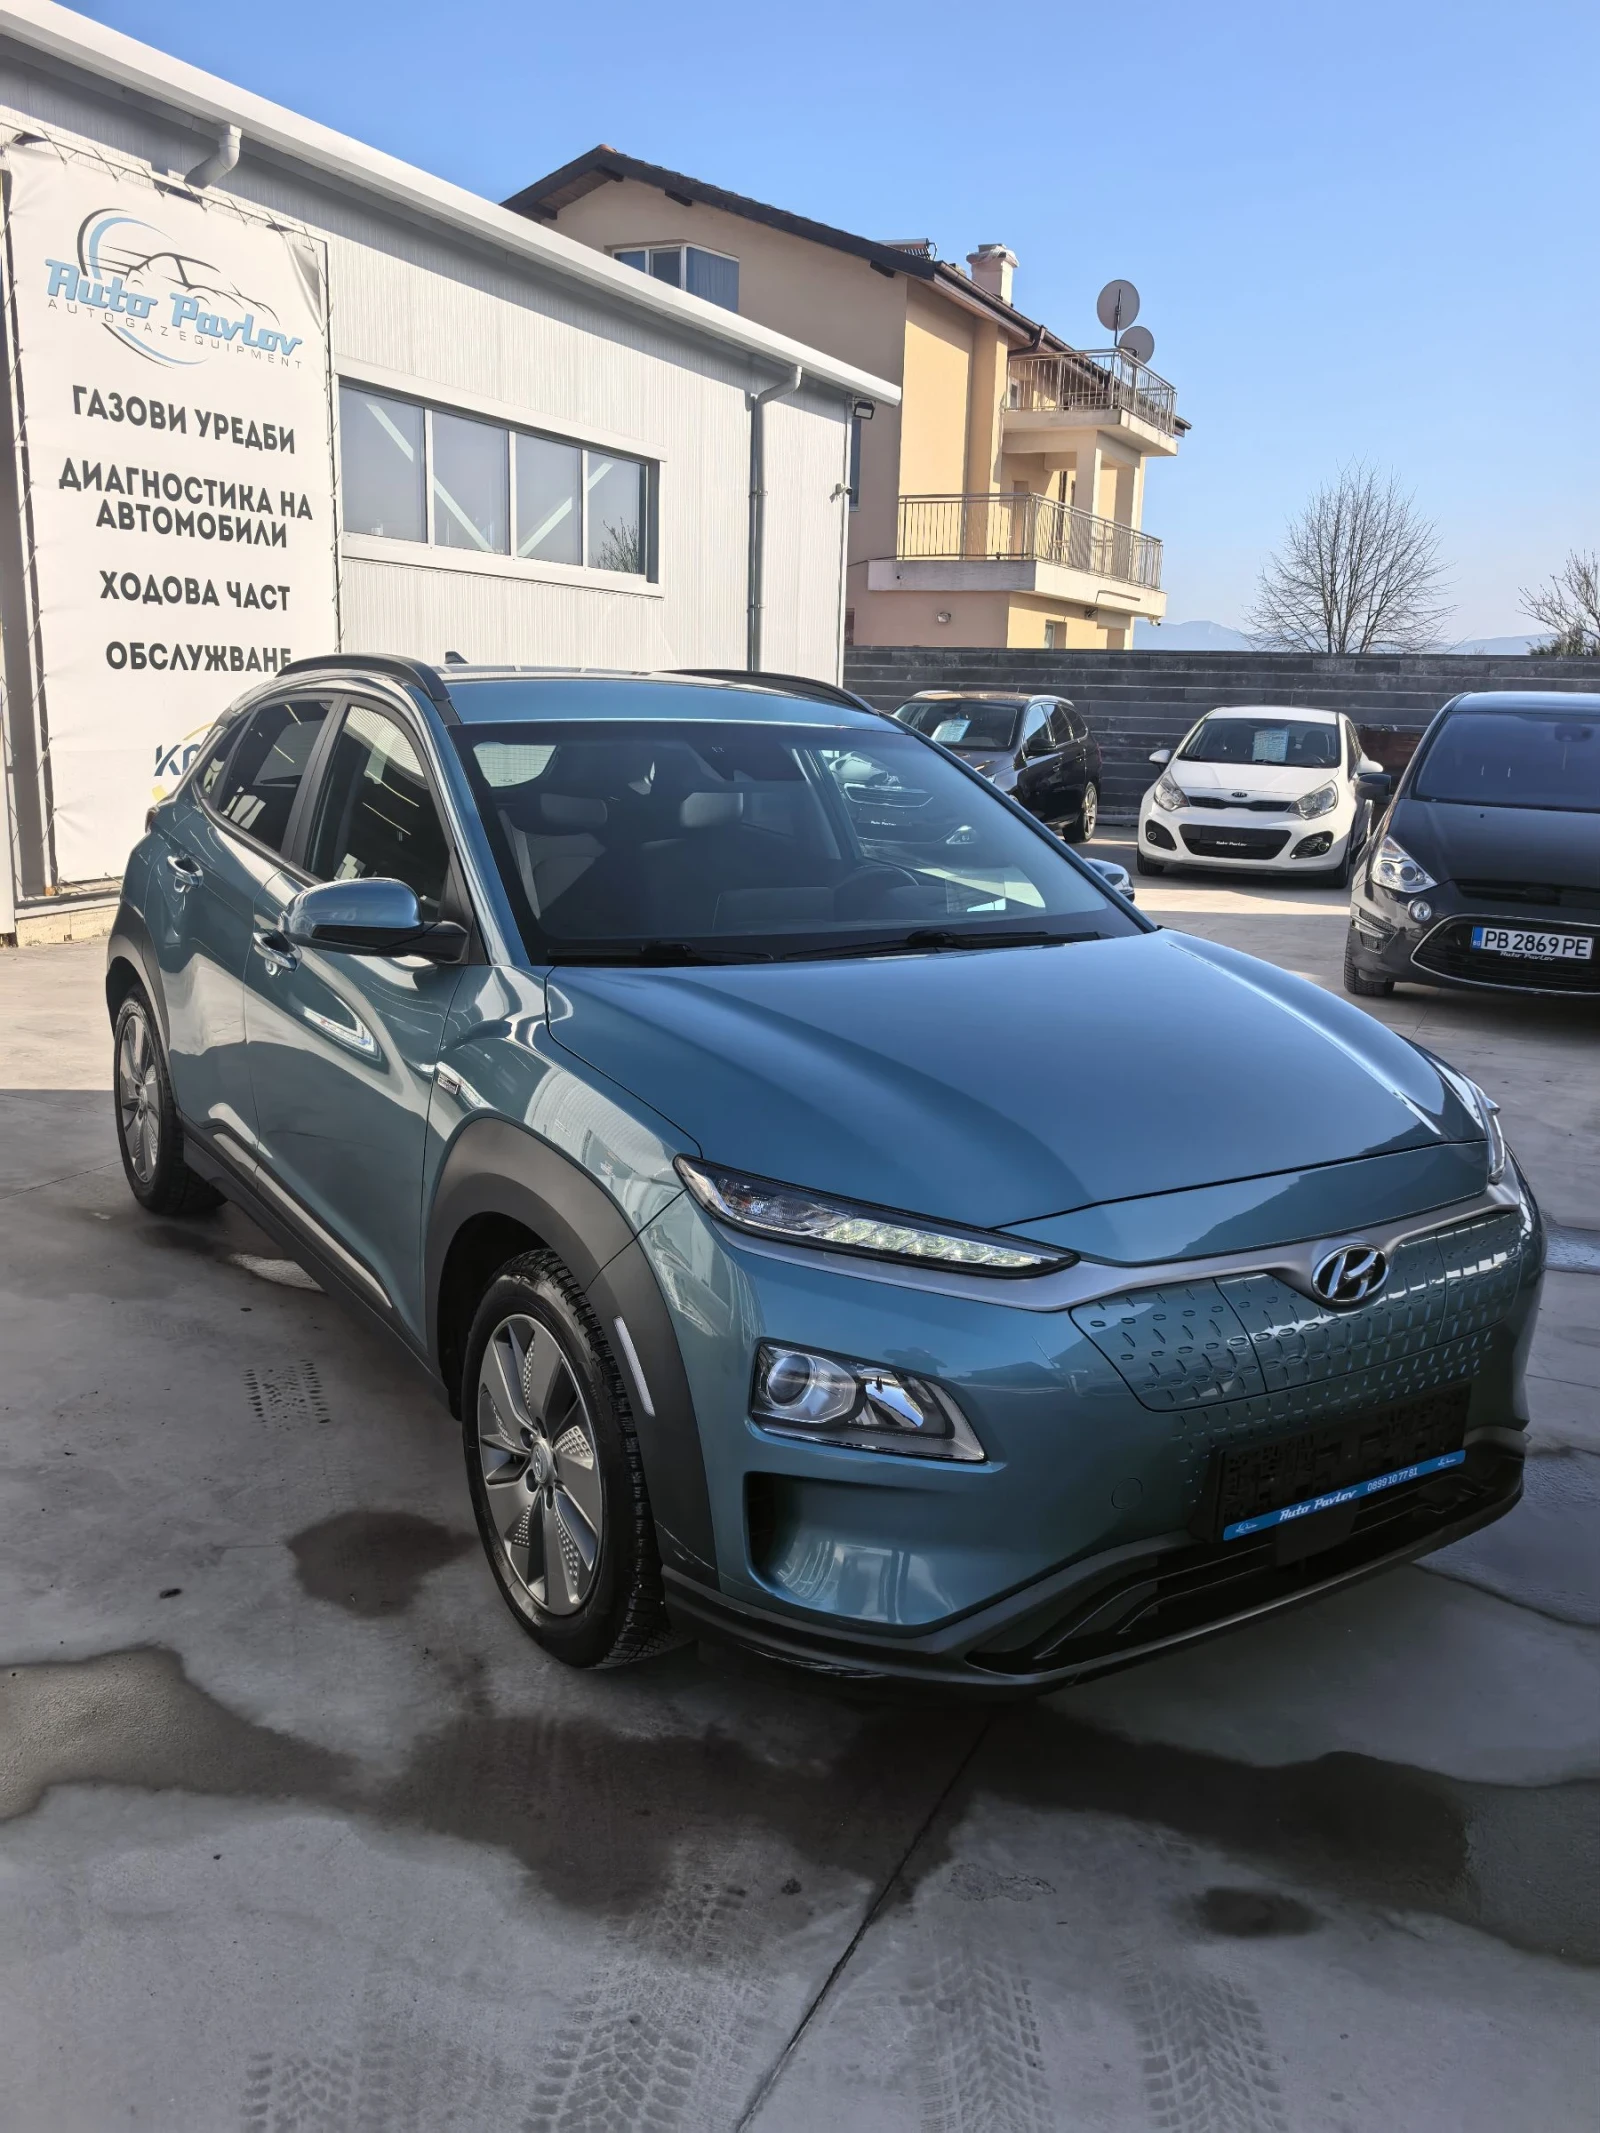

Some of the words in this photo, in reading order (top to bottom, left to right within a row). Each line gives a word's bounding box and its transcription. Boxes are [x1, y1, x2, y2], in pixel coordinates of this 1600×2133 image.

[45, 258, 158, 319] Auto
[169, 291, 303, 356] Pavlov
[72, 384, 187, 435] ГАЗОВИ
[194, 408, 296, 455] УРЕДБИ
[58, 457, 274, 515] ДИАГНОСТИКА
[280, 490, 313, 521] НА
[95, 498, 288, 549] АВТОМОБИЛИ
[99, 570, 220, 607] ХОДОВА
[226, 580, 291, 612] ЧАСТ
[106, 641, 292, 673] ОБСЛУЖВАНЕ
[1484, 930, 1509, 949] PB
[1512, 933, 1559, 954] 2869
[1562, 938, 1589, 957] PE
[1279, 1504, 1312, 1521] Auto
[1314, 1489, 1358, 1510] Pavlov
